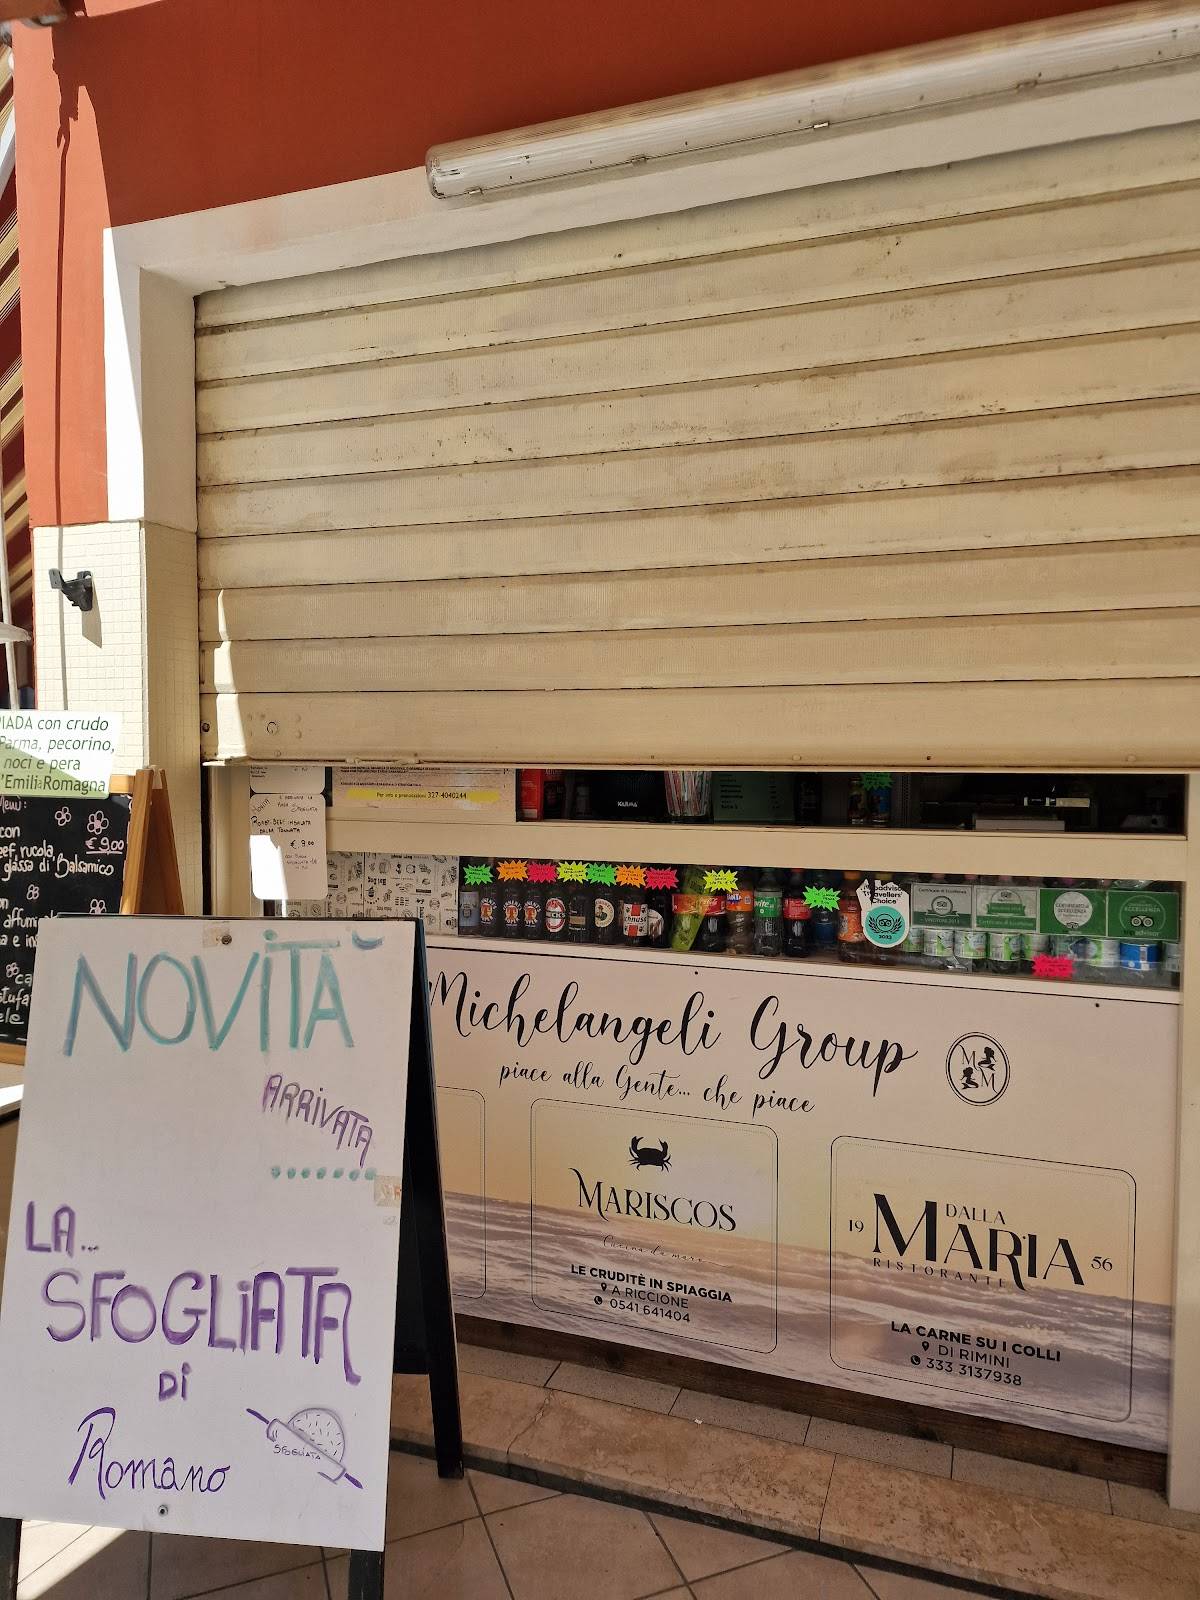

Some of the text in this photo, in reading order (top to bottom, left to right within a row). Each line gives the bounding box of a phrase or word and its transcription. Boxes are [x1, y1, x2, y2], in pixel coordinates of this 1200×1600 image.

[37, 719, 61, 730] con
[66, 715, 109, 731] crudo
[47, 736, 115, 753] pecorino,
[3, 755, 81, 773] noci e pera
[39, 858, 50, 873] di
[54, 852, 115, 879] Balsamico
[12, 935, 21, 947] e
[429, 970, 919, 1098] Michelangeli Group
[499, 1061, 553, 1089] piace
[562, 1060, 605, 1090] alla
[703, 1074, 743, 1111] che
[751, 1090, 816, 1119] piace
[568, 1167, 737, 1232] MARISCOS
[945, 1202, 1007, 1226] DALLA
[848, 1192, 1114, 1292] 19 MARIA 56
[571, 1264, 587, 1276] LE
[649, 1278, 663, 1291] IN
[666, 1281, 733, 1303] SPIAGGIA
[872, 1257, 1007, 1289] RISTORANTE
[609, 1297, 692, 1323] 0541 641404
[611, 1285, 690, 1310] A RICCIONE
[890, 1320, 911, 1335] LA
[915, 1325, 972, 1345] CARNE
[975, 1336, 999, 1351] SU
[1011, 1343, 1061, 1363] COLLI
[937, 1344, 1011, 1369] DI RIMINI
[926, 1356, 1023, 1387] 333 3137938
[67, 1406, 232, 1501] Romano
